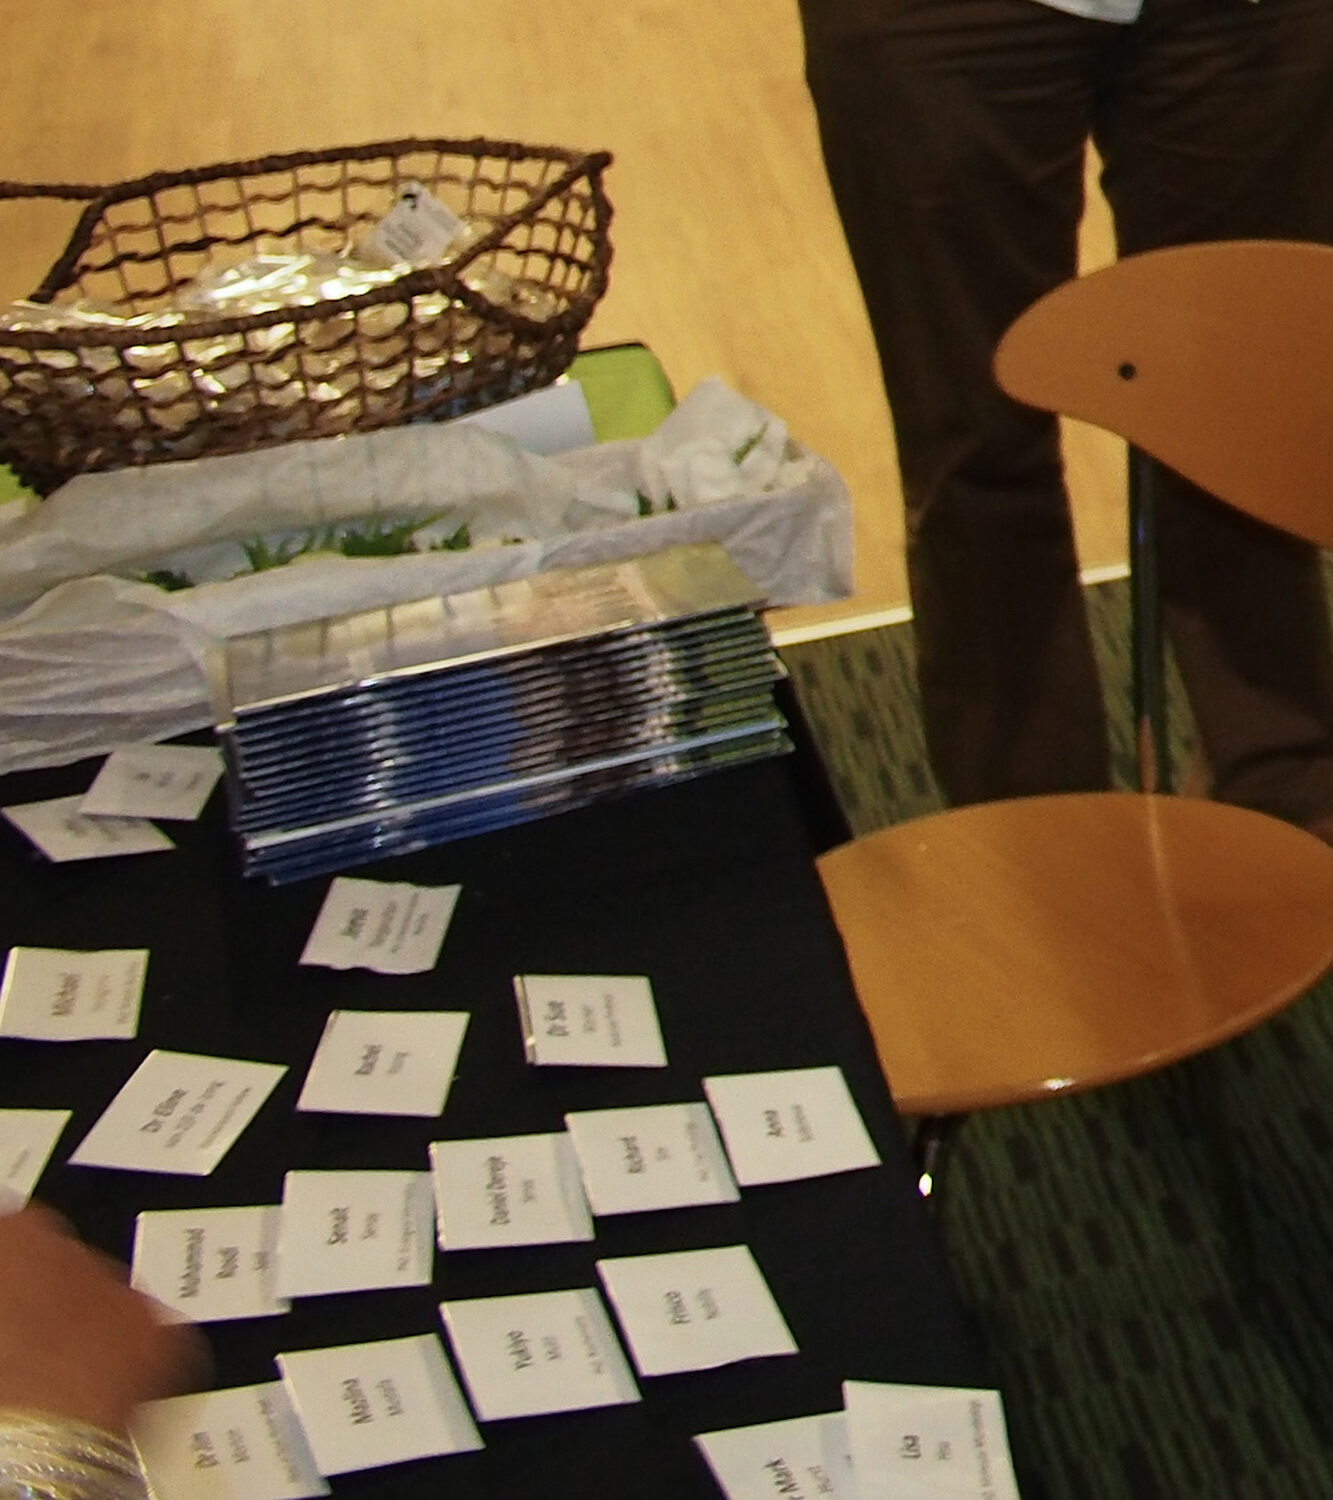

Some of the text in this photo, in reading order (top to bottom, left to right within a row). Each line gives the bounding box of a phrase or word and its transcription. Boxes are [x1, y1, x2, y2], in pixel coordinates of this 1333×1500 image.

[545, 1023, 570, 1037] Dr
[488, 1191, 512, 1226] Daniel
[900, 1434, 922, 1459] Lisa
[763, 1455, 801, 1495] Mark
